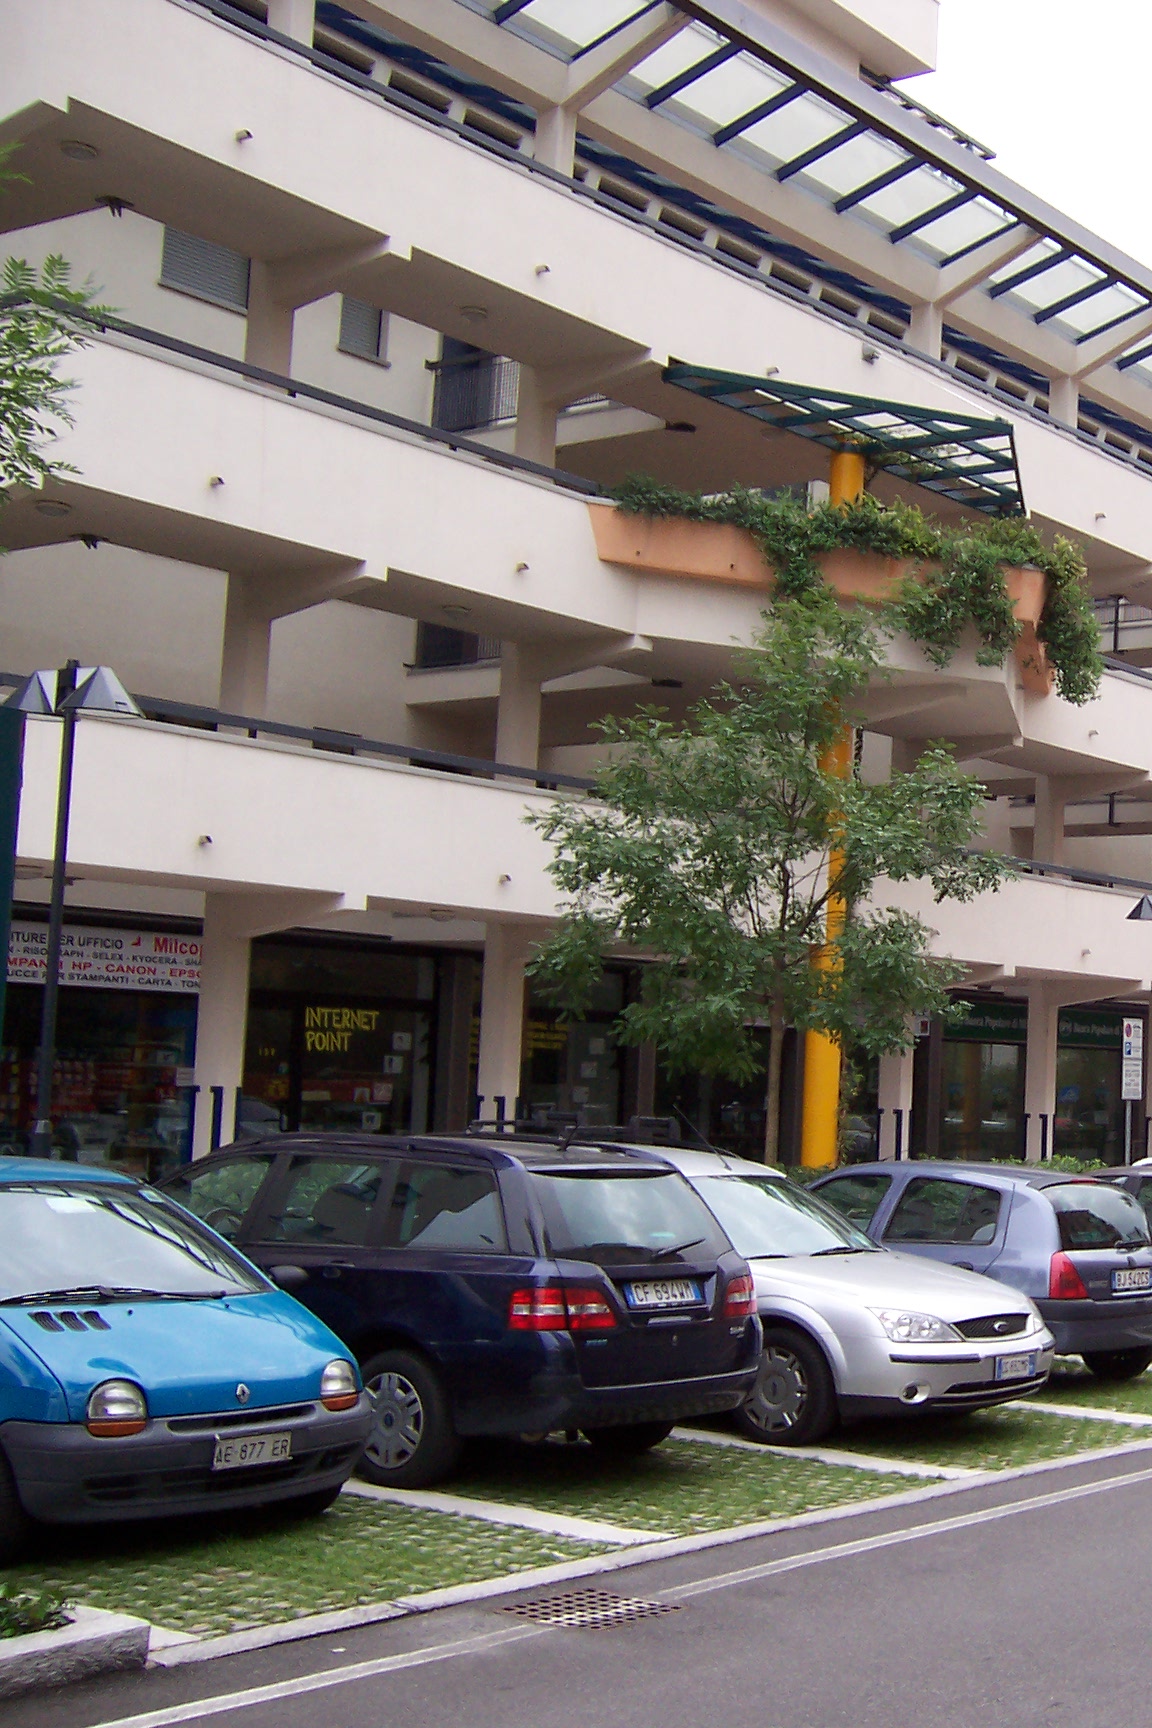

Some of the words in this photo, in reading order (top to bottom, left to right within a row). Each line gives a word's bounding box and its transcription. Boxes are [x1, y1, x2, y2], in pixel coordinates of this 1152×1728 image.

[78, 937, 123, 949] UFFICIO
[72, 961, 92, 970] HP
[105, 964, 157, 975] CANON
[132, 954, 177, 965] KYOCERA
[68, 972, 128, 984] STAMPANTI
[138, 977, 172, 986] CARTA
[305, 1006, 379, 1030] INTERNET
[305, 1031, 352, 1051] POINT
[634, 1281, 650, 1302] CF
[216, 1446, 233, 1462] AE
[240, 1441, 265, 1460] 877
[272, 1439, 289, 1456] ER
